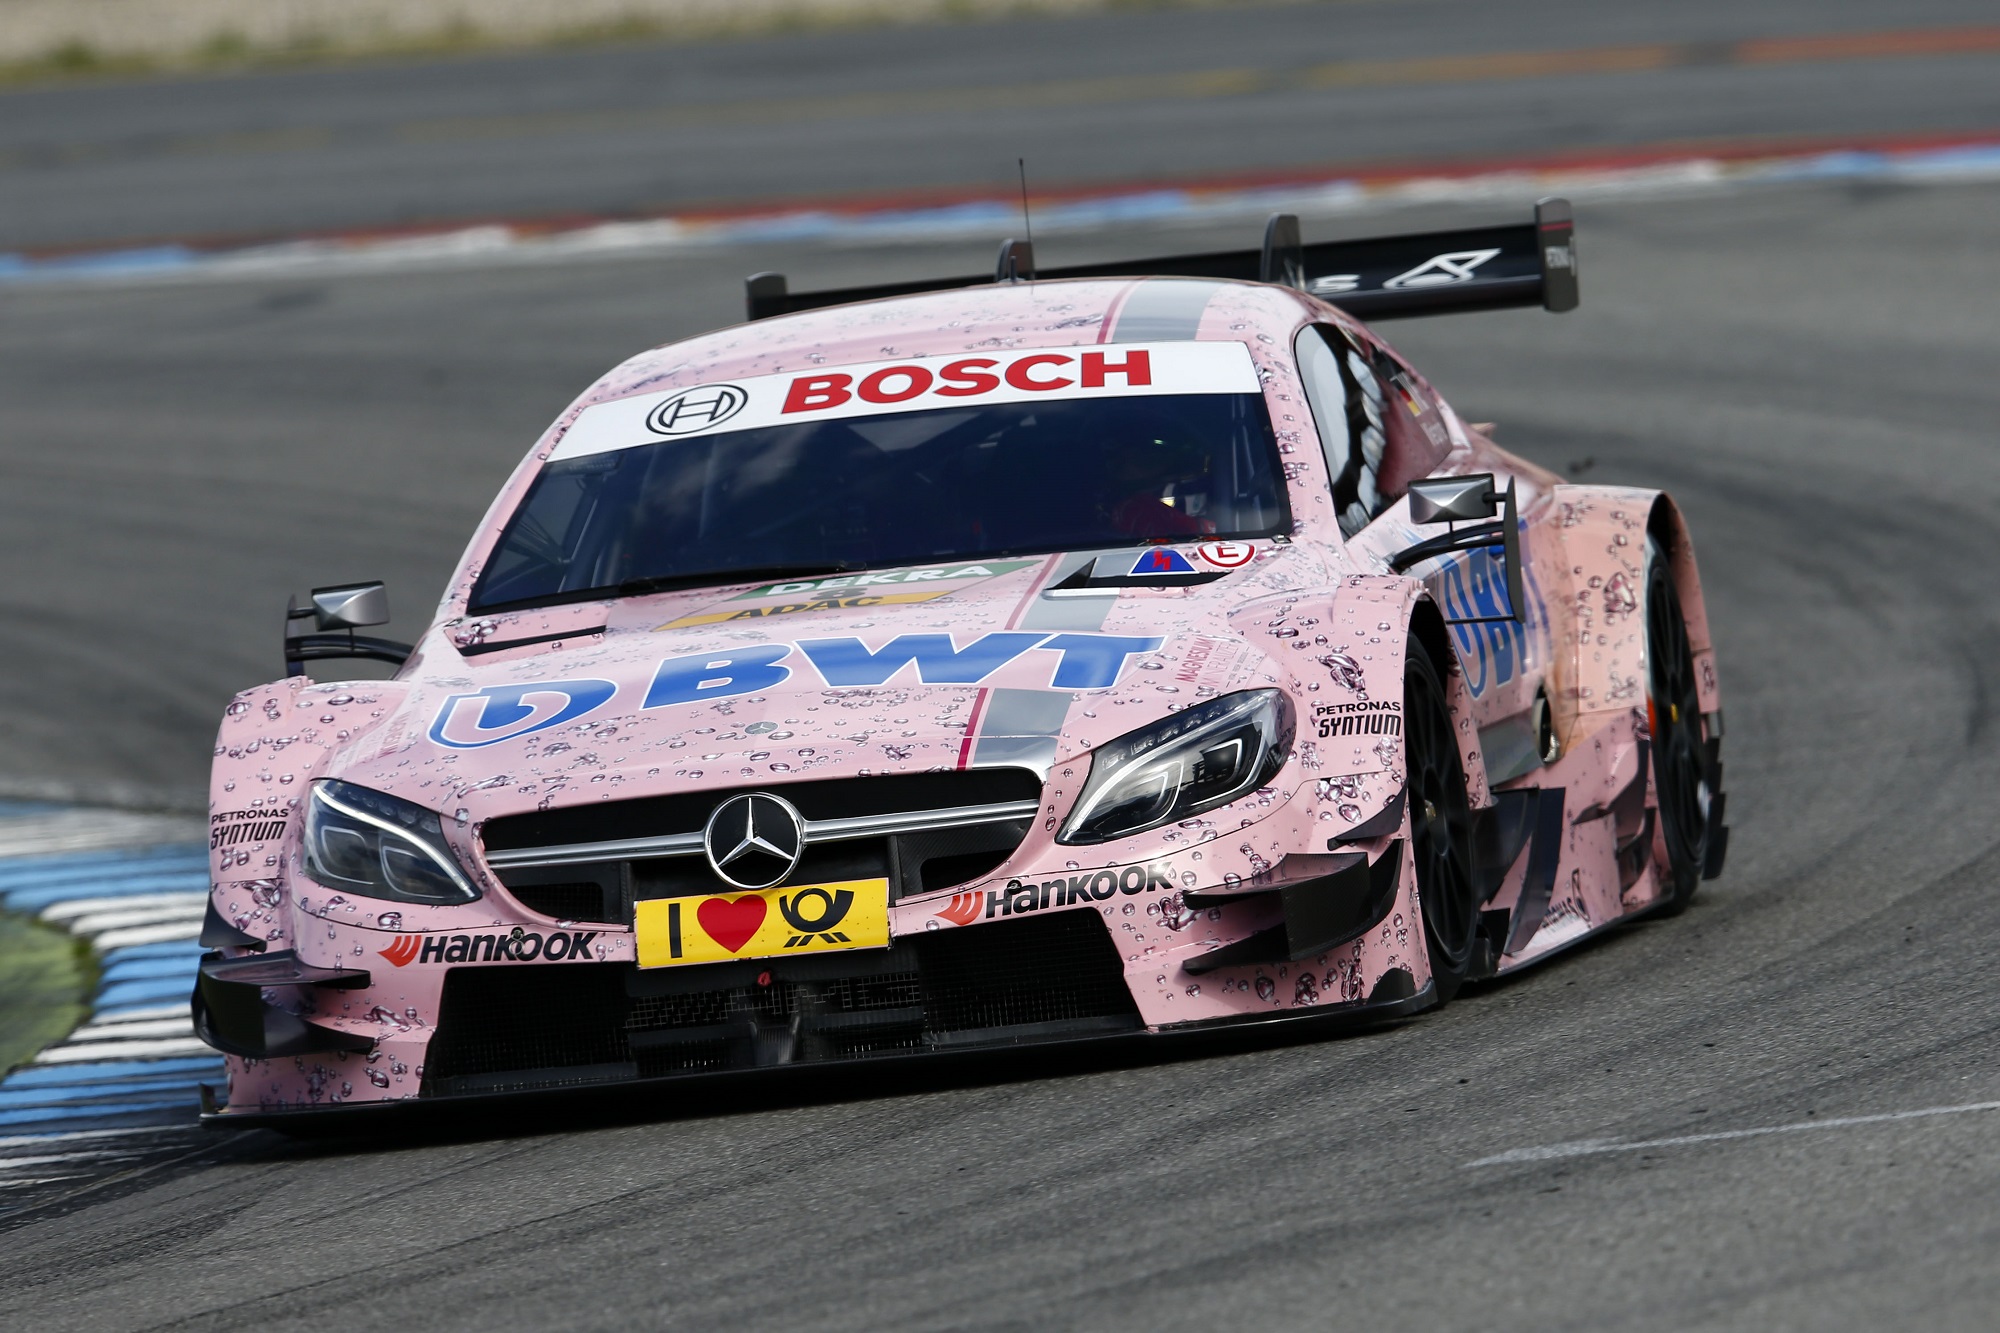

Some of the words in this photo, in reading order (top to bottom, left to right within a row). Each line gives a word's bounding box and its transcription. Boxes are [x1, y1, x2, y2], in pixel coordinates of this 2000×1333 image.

[780, 349, 1152, 414] BOSCH
[1215, 545, 1239, 558] E
[766, 565, 993, 595] DEKRA
[728, 596, 884, 620] ADAC
[641, 632, 1166, 709] BWT
[1174, 637, 1216, 683] MAGNESIUM
[1316, 701, 1401, 716] PETRONAS
[1318, 713, 1402, 738] SYNTIUM
[211, 808, 289, 825] PETRONAS
[210, 821, 287, 850] SYNTIUM
[668, 902, 683, 959] I
